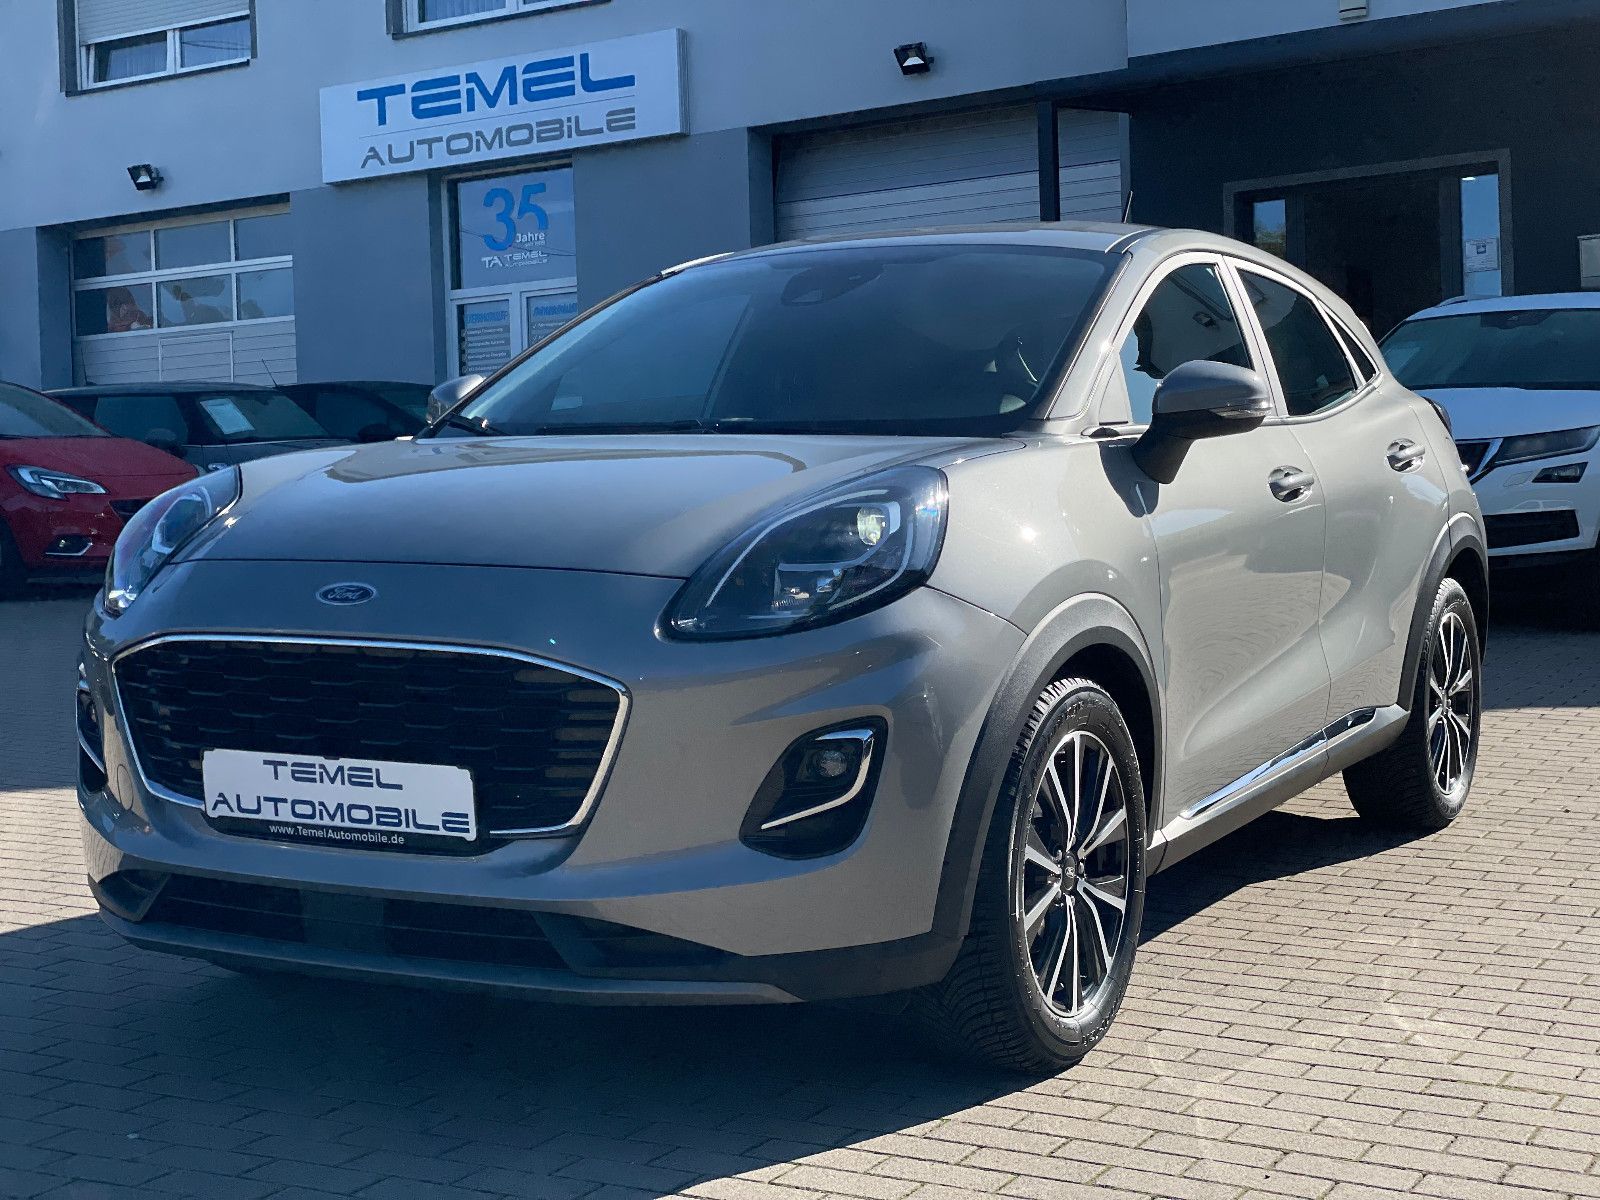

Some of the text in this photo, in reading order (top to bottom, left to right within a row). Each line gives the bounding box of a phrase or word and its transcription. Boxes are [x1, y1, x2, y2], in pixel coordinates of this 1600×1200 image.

[357, 52, 636, 127] TEMEL
[360, 106, 636, 169] AUTOMOBILE
[482, 182, 549, 252] 35
[516, 232, 545, 243] Jahre
[481, 250, 548, 269] TA TEMEL
[327, 586, 364, 600] Ford
[262, 759, 404, 791] TEMEL
[211, 792, 471, 834] AUTOMOBILE
[269, 823, 405, 845] www.TemelAutomobile.de
